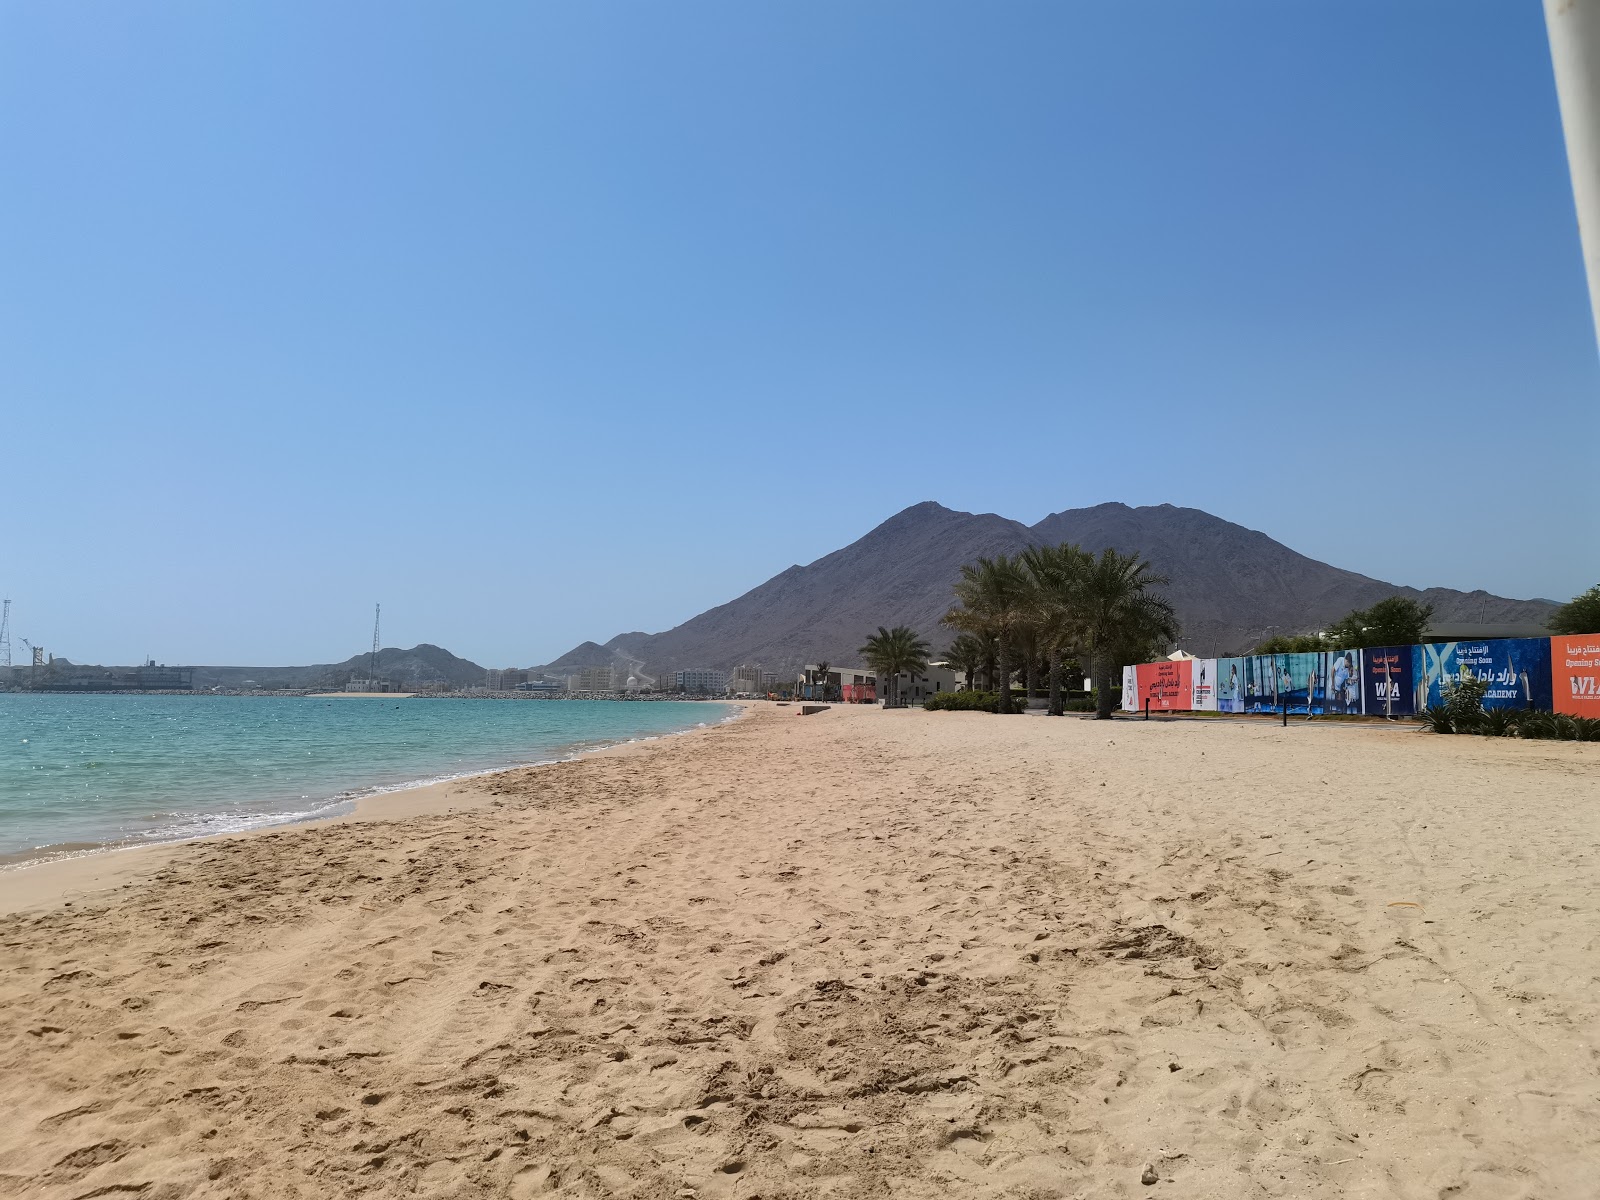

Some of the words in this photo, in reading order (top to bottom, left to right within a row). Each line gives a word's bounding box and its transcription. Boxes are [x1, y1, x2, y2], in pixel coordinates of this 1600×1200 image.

[1456, 657, 1478, 666] Opening
[1566, 659, 1592, 668] Opening
[1374, 682, 1400, 697] WA
